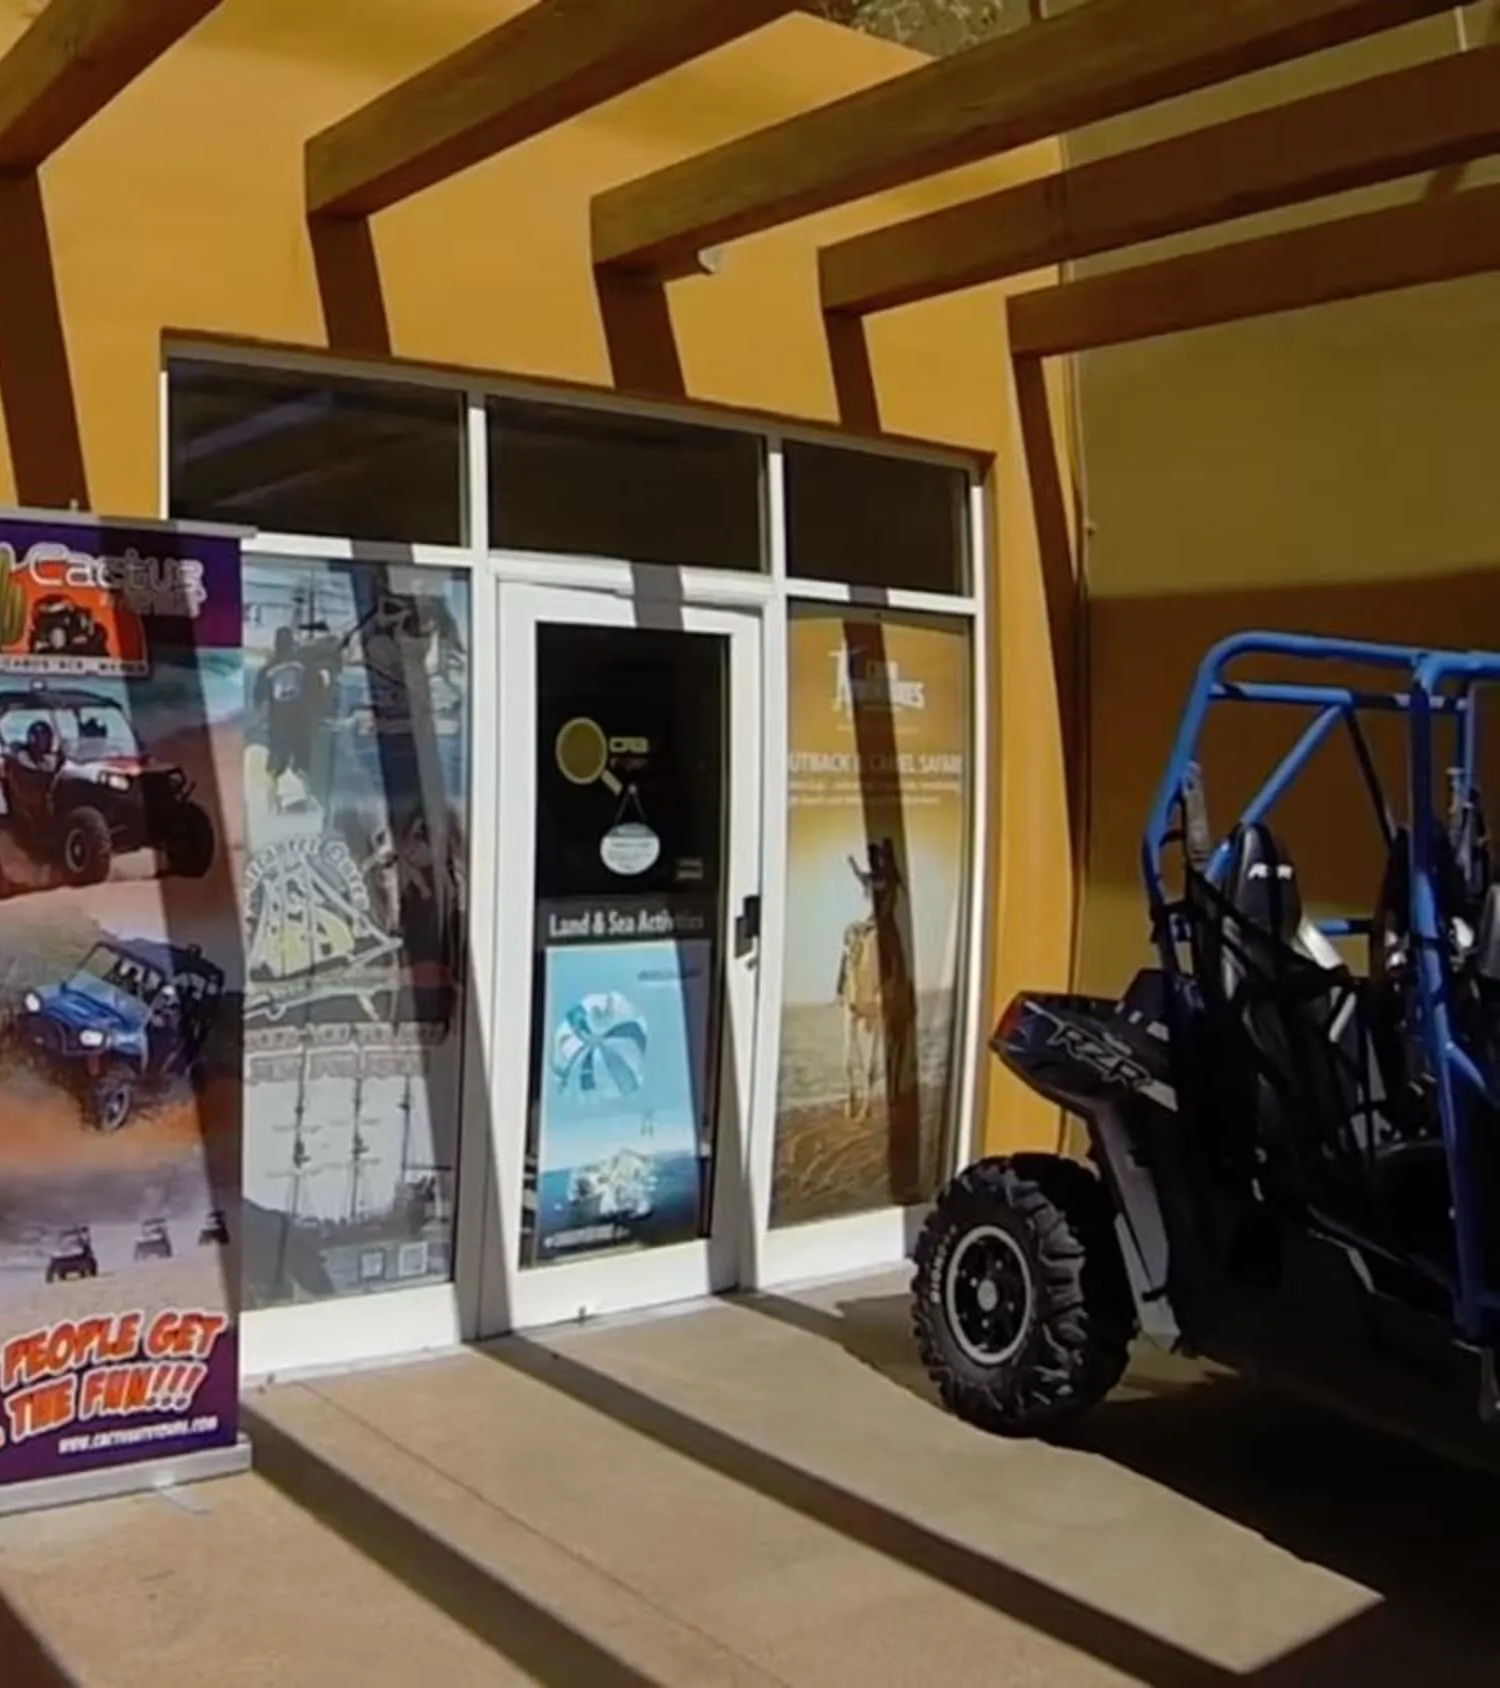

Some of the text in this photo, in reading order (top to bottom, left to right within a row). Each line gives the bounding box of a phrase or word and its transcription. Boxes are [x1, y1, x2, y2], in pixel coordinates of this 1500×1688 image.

[28, 544, 204, 591] Cactus
[550, 911, 590, 937] Land
[593, 910, 605, 935] &
[608, 908, 636, 933] Sea
[0, 1309, 145, 1392] PEOPLE
[143, 1310, 227, 1360] GET
[6, 1373, 77, 1442] THE
[78, 1362, 208, 1421] FUN!!!
